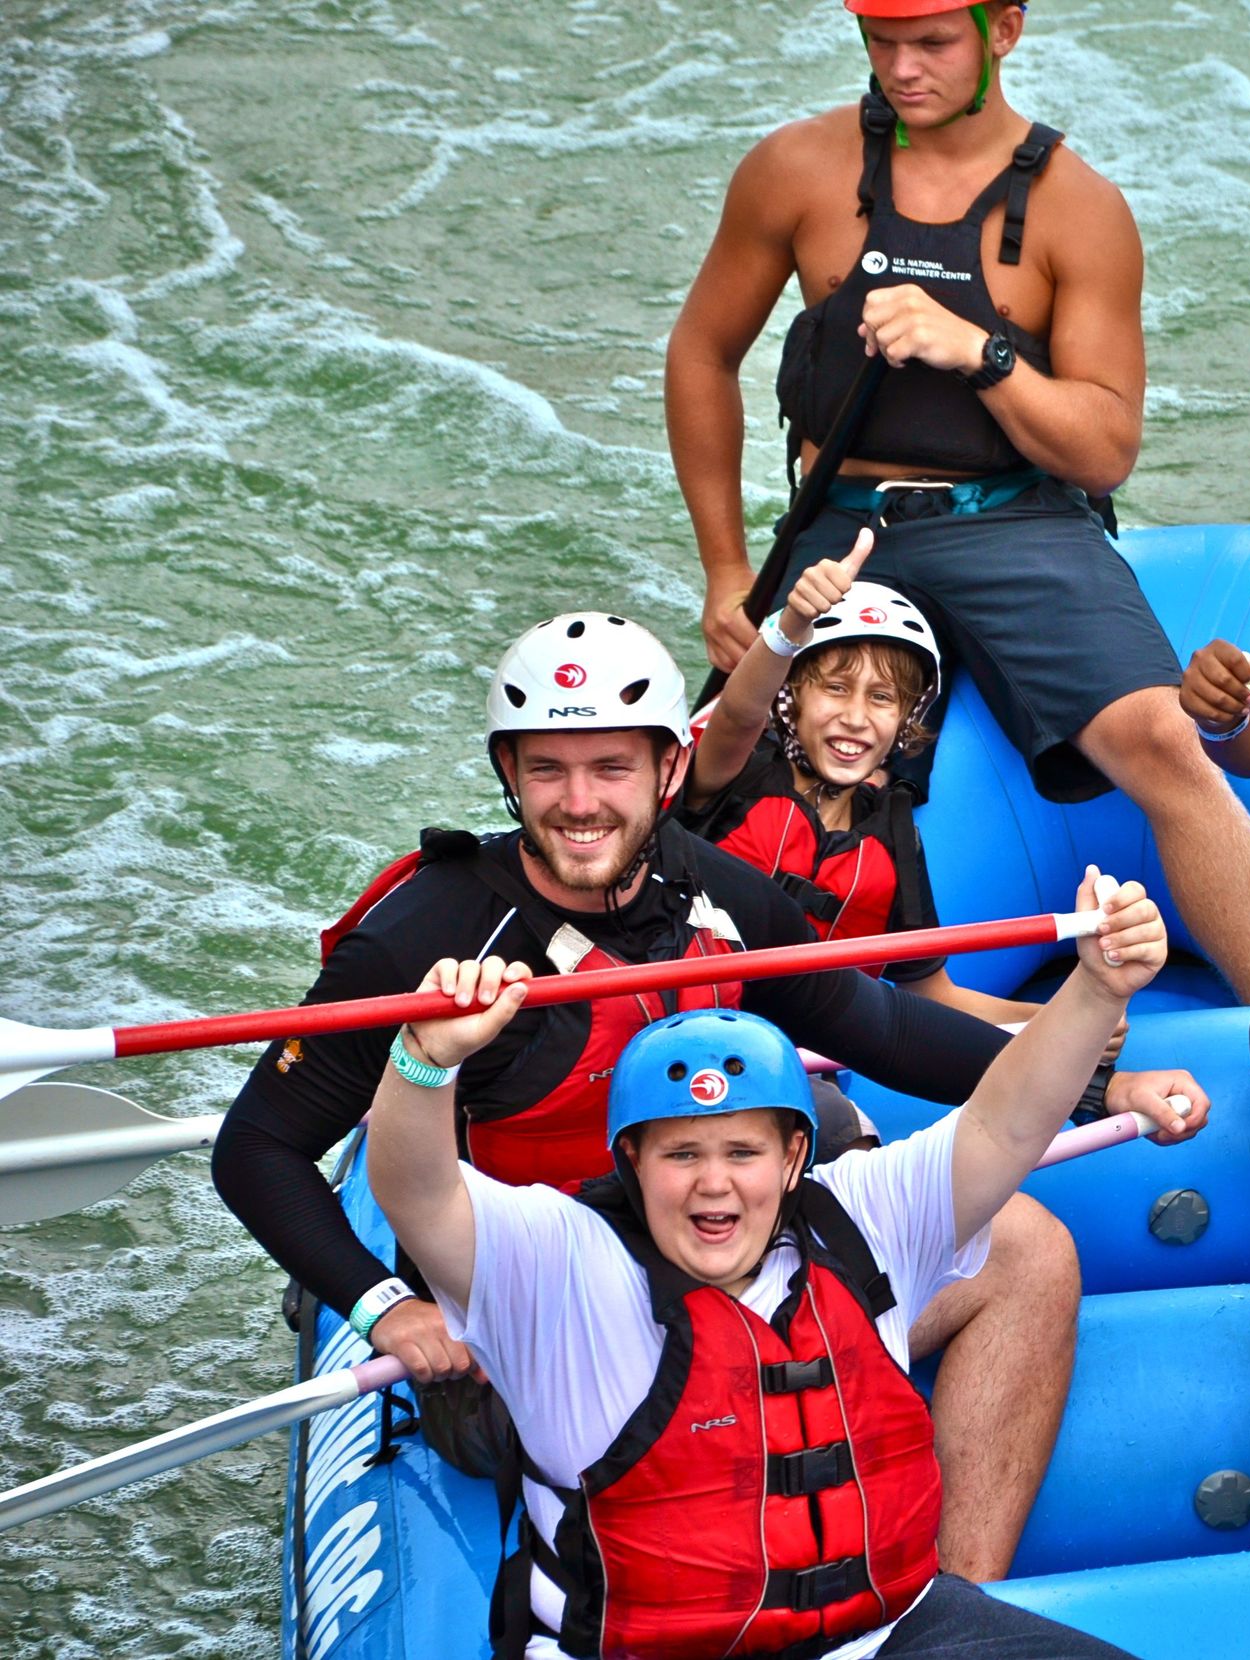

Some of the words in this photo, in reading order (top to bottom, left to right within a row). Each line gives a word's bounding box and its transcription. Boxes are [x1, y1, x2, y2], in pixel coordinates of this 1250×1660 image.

[907, 258, 944, 271] NATIONAL
[892, 265, 940, 278] WHITEWATER
[941, 271, 972, 281] CENTER
[549, 706, 598, 718] NRS
[690, 1414, 737, 1433] NRS
